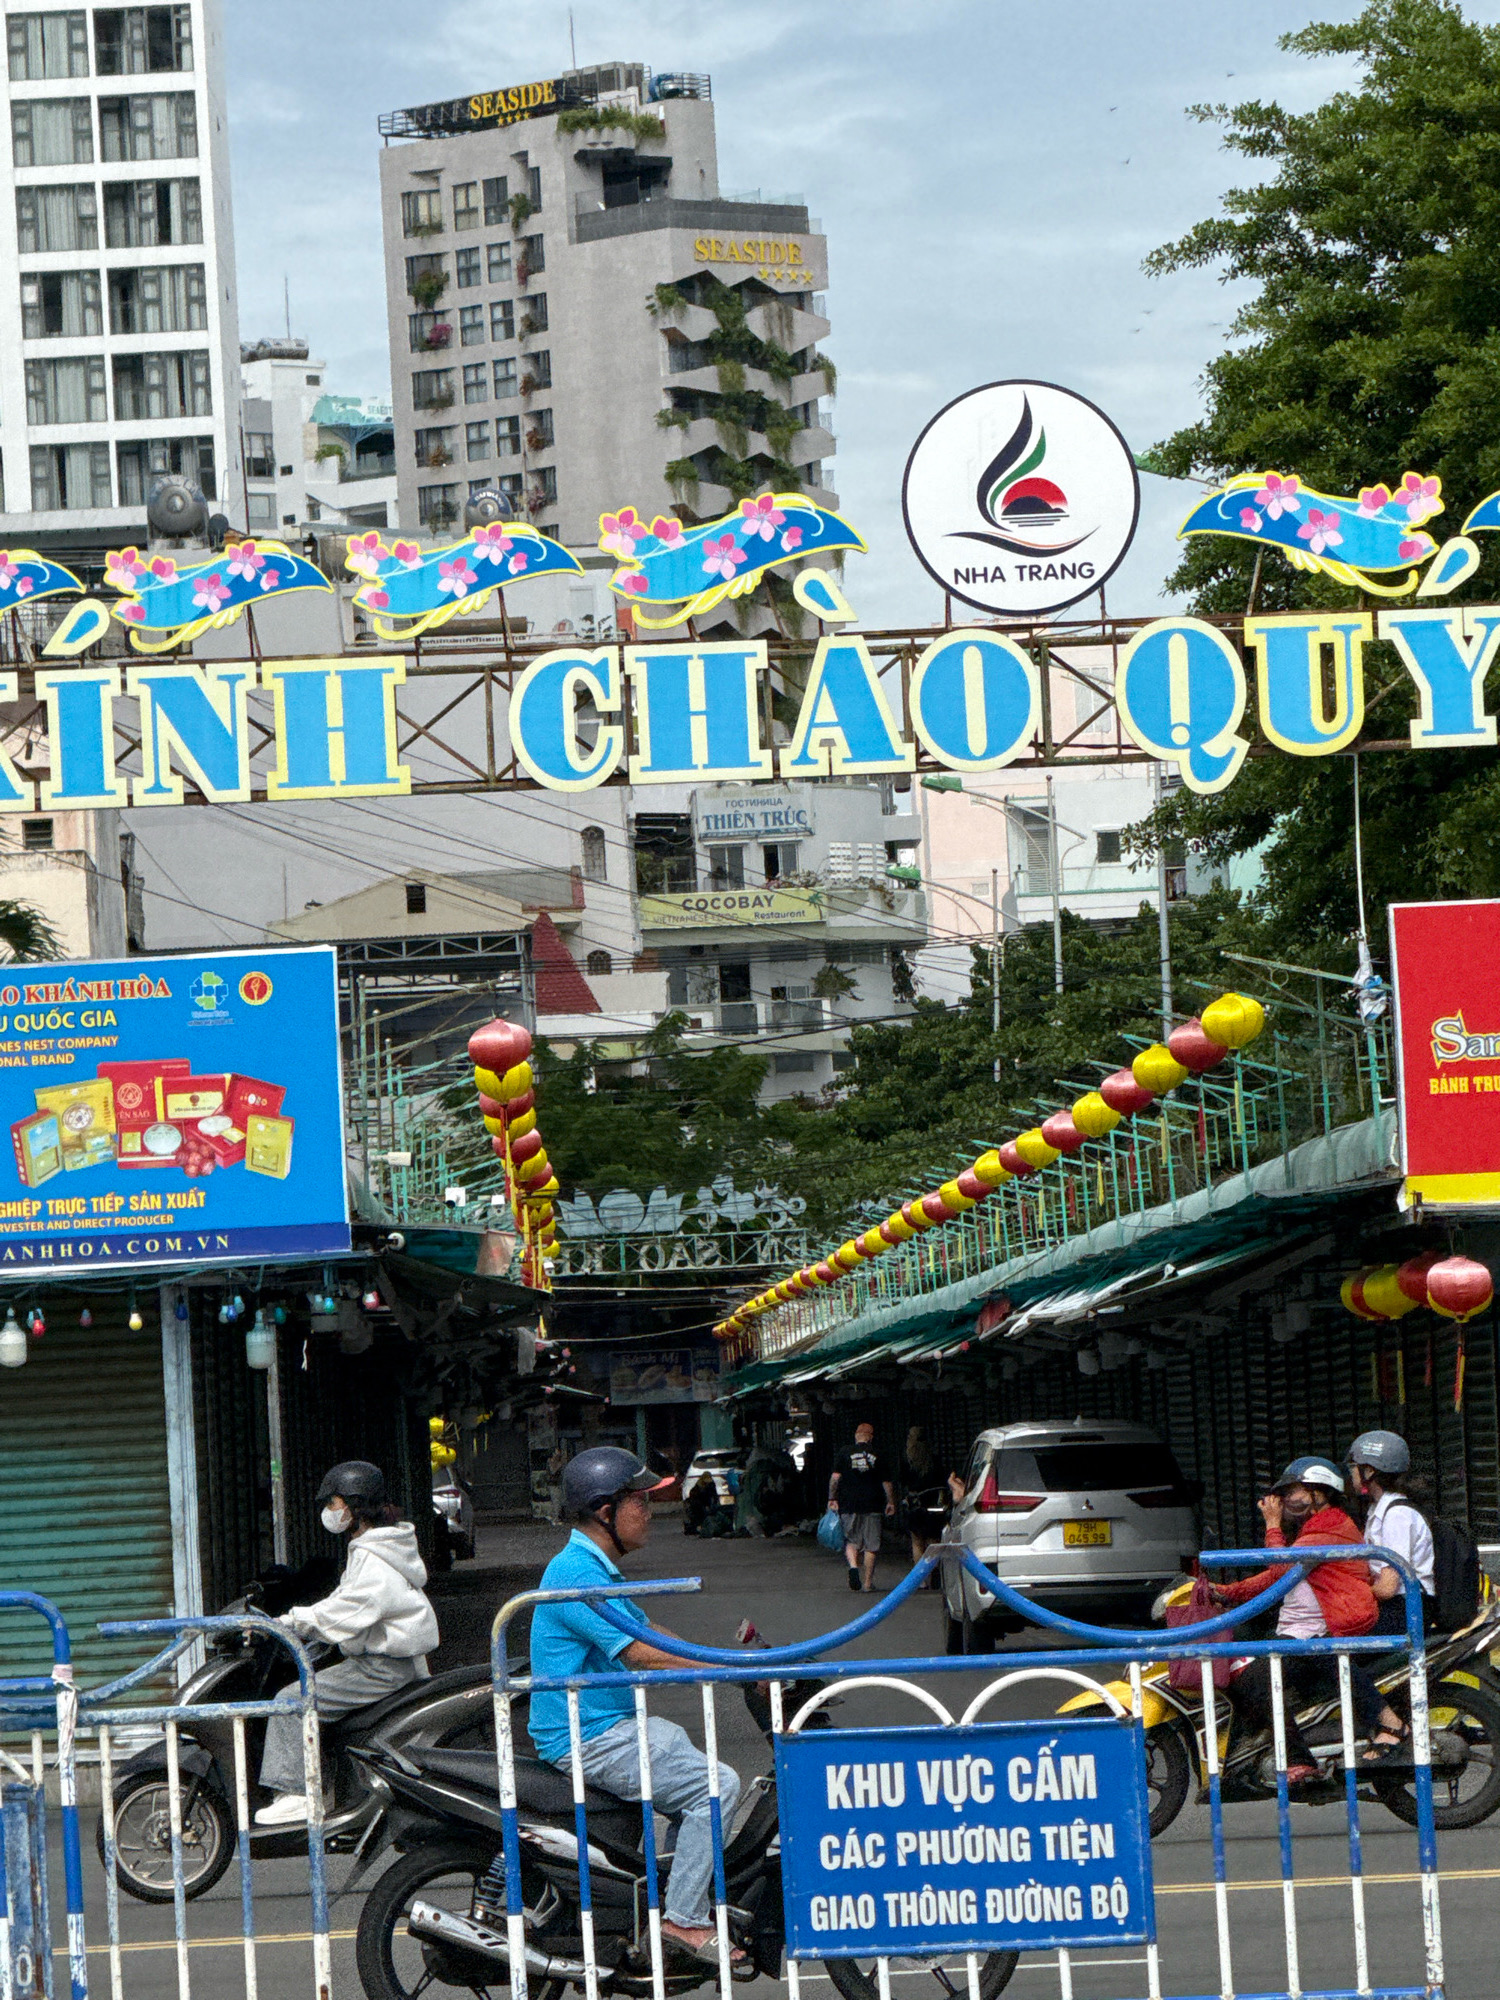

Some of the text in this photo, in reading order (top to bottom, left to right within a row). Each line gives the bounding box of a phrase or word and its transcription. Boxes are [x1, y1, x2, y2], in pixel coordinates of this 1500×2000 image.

[470, 80, 557, 120] SEASIDE
[694, 238, 804, 265] SEASIDE
[953, 562, 1095, 585] NHA TRANG
[509, 568, 1040, 792] CHÀO
[1115, 536, 1500, 794] QUÝ
[725, 797, 783, 809] ГОСТИНИЦА
[702, 806, 808, 830] THIÊN TRÚC
[682, 895, 775, 912] COCOBAY
[754, 910, 806, 920] Restaurant
[0, 974, 172, 1006] O KHÁNH HÒA
[14, 1006, 75, 1033] QUỐC
[80, 1009, 117, 1027] GIA
[24, 1039, 54, 1051] NEST
[57, 1036, 119, 1049] COMPANY
[31, 1053, 75, 1066] BRAND
[1429, 1073, 1469, 1094] BÁNH
[46, 1197, 86, 1218] TRỰC
[91, 1191, 125, 1212] TIẾP
[129, 1190, 162, 1211] SẢN
[166, 1187, 206, 1209] XUẤT
[47, 1220, 71, 1231] AND
[73, 1218, 112, 1229] DIRECT
[115, 1214, 174, 1227] PRODUCER
[1078, 1522, 1097, 1533] 79H
[826, 1739, 1097, 1812] KHU VỰC CẤM
[819, 1817, 1114, 1870] CÁC PHƯƠNG TIỆN
[810, 1876, 1129, 1931] GIAO THÔNG ĐƯỜNG BỘ
